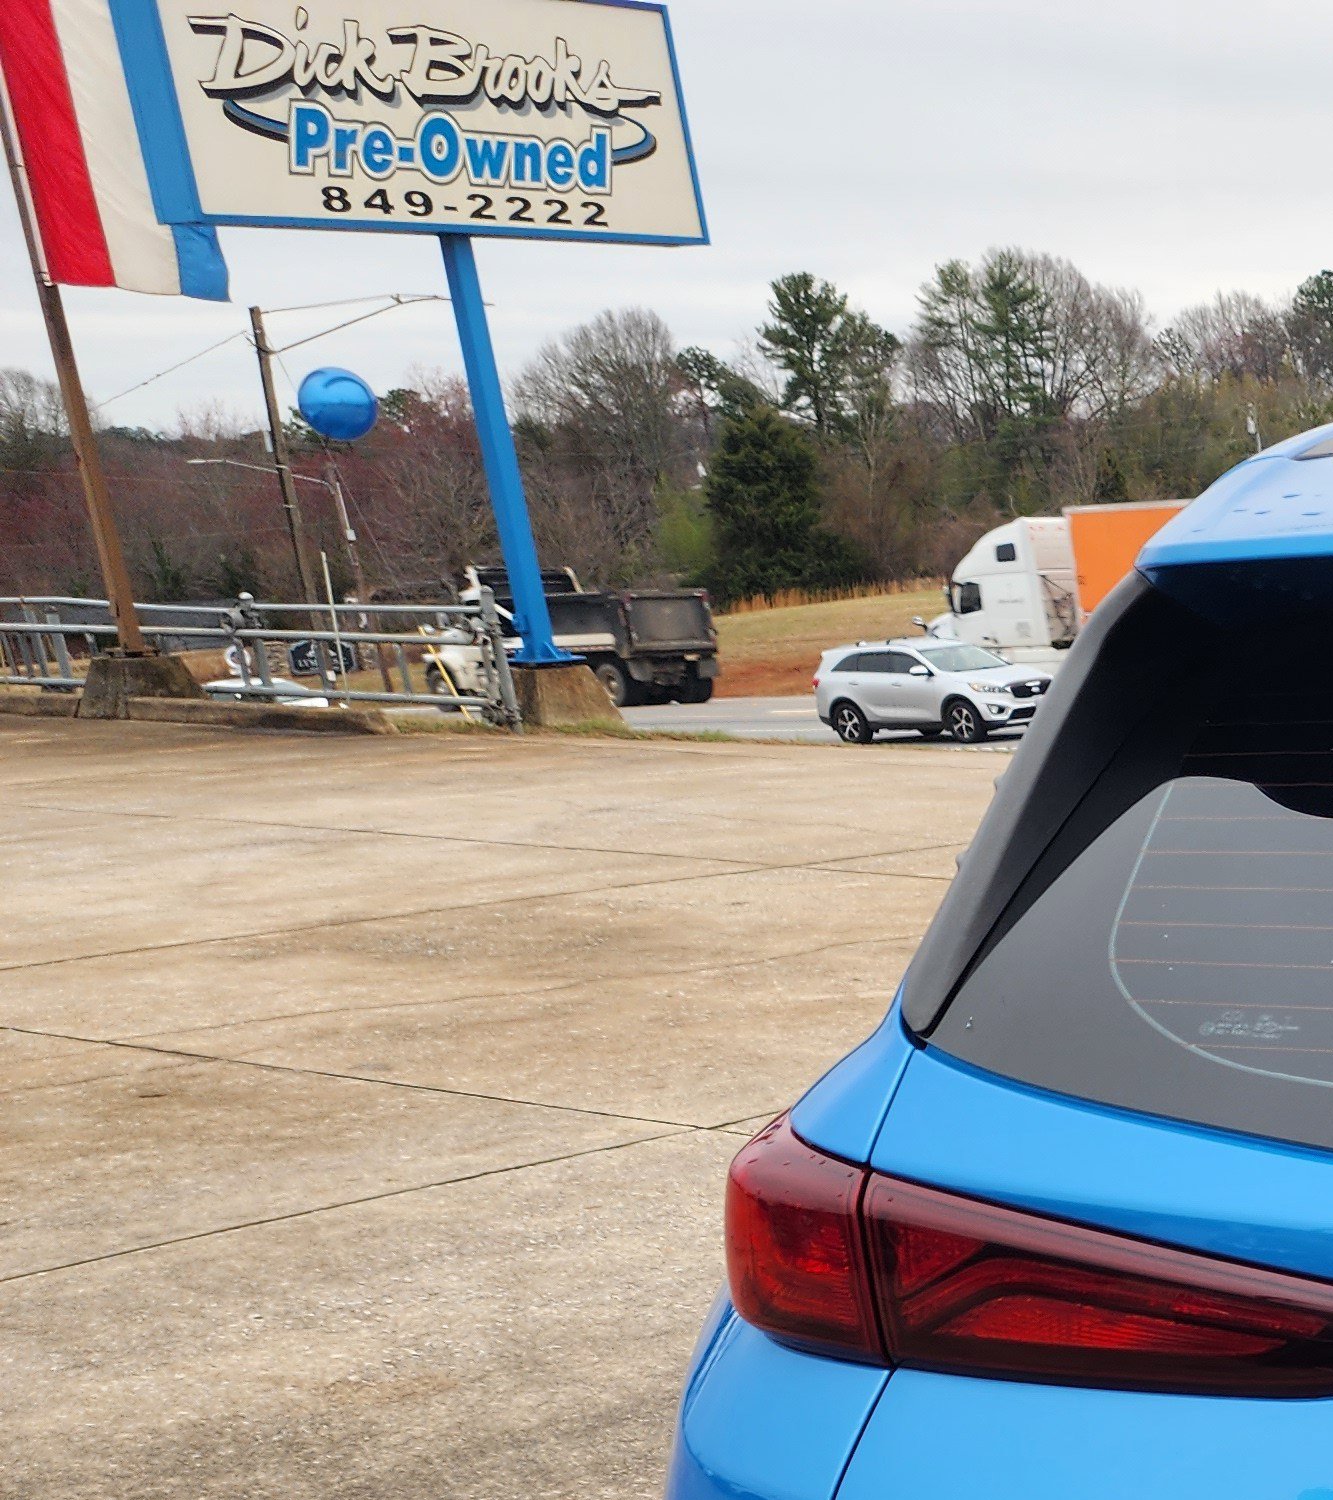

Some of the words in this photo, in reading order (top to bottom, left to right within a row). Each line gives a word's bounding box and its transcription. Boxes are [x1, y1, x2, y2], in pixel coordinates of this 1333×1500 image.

[187, 6, 396, 99] Dick
[386, 25, 662, 115] Brooks
[290, 101, 612, 194] Pre-Owned
[321, 186, 609, 227] 849-2222
